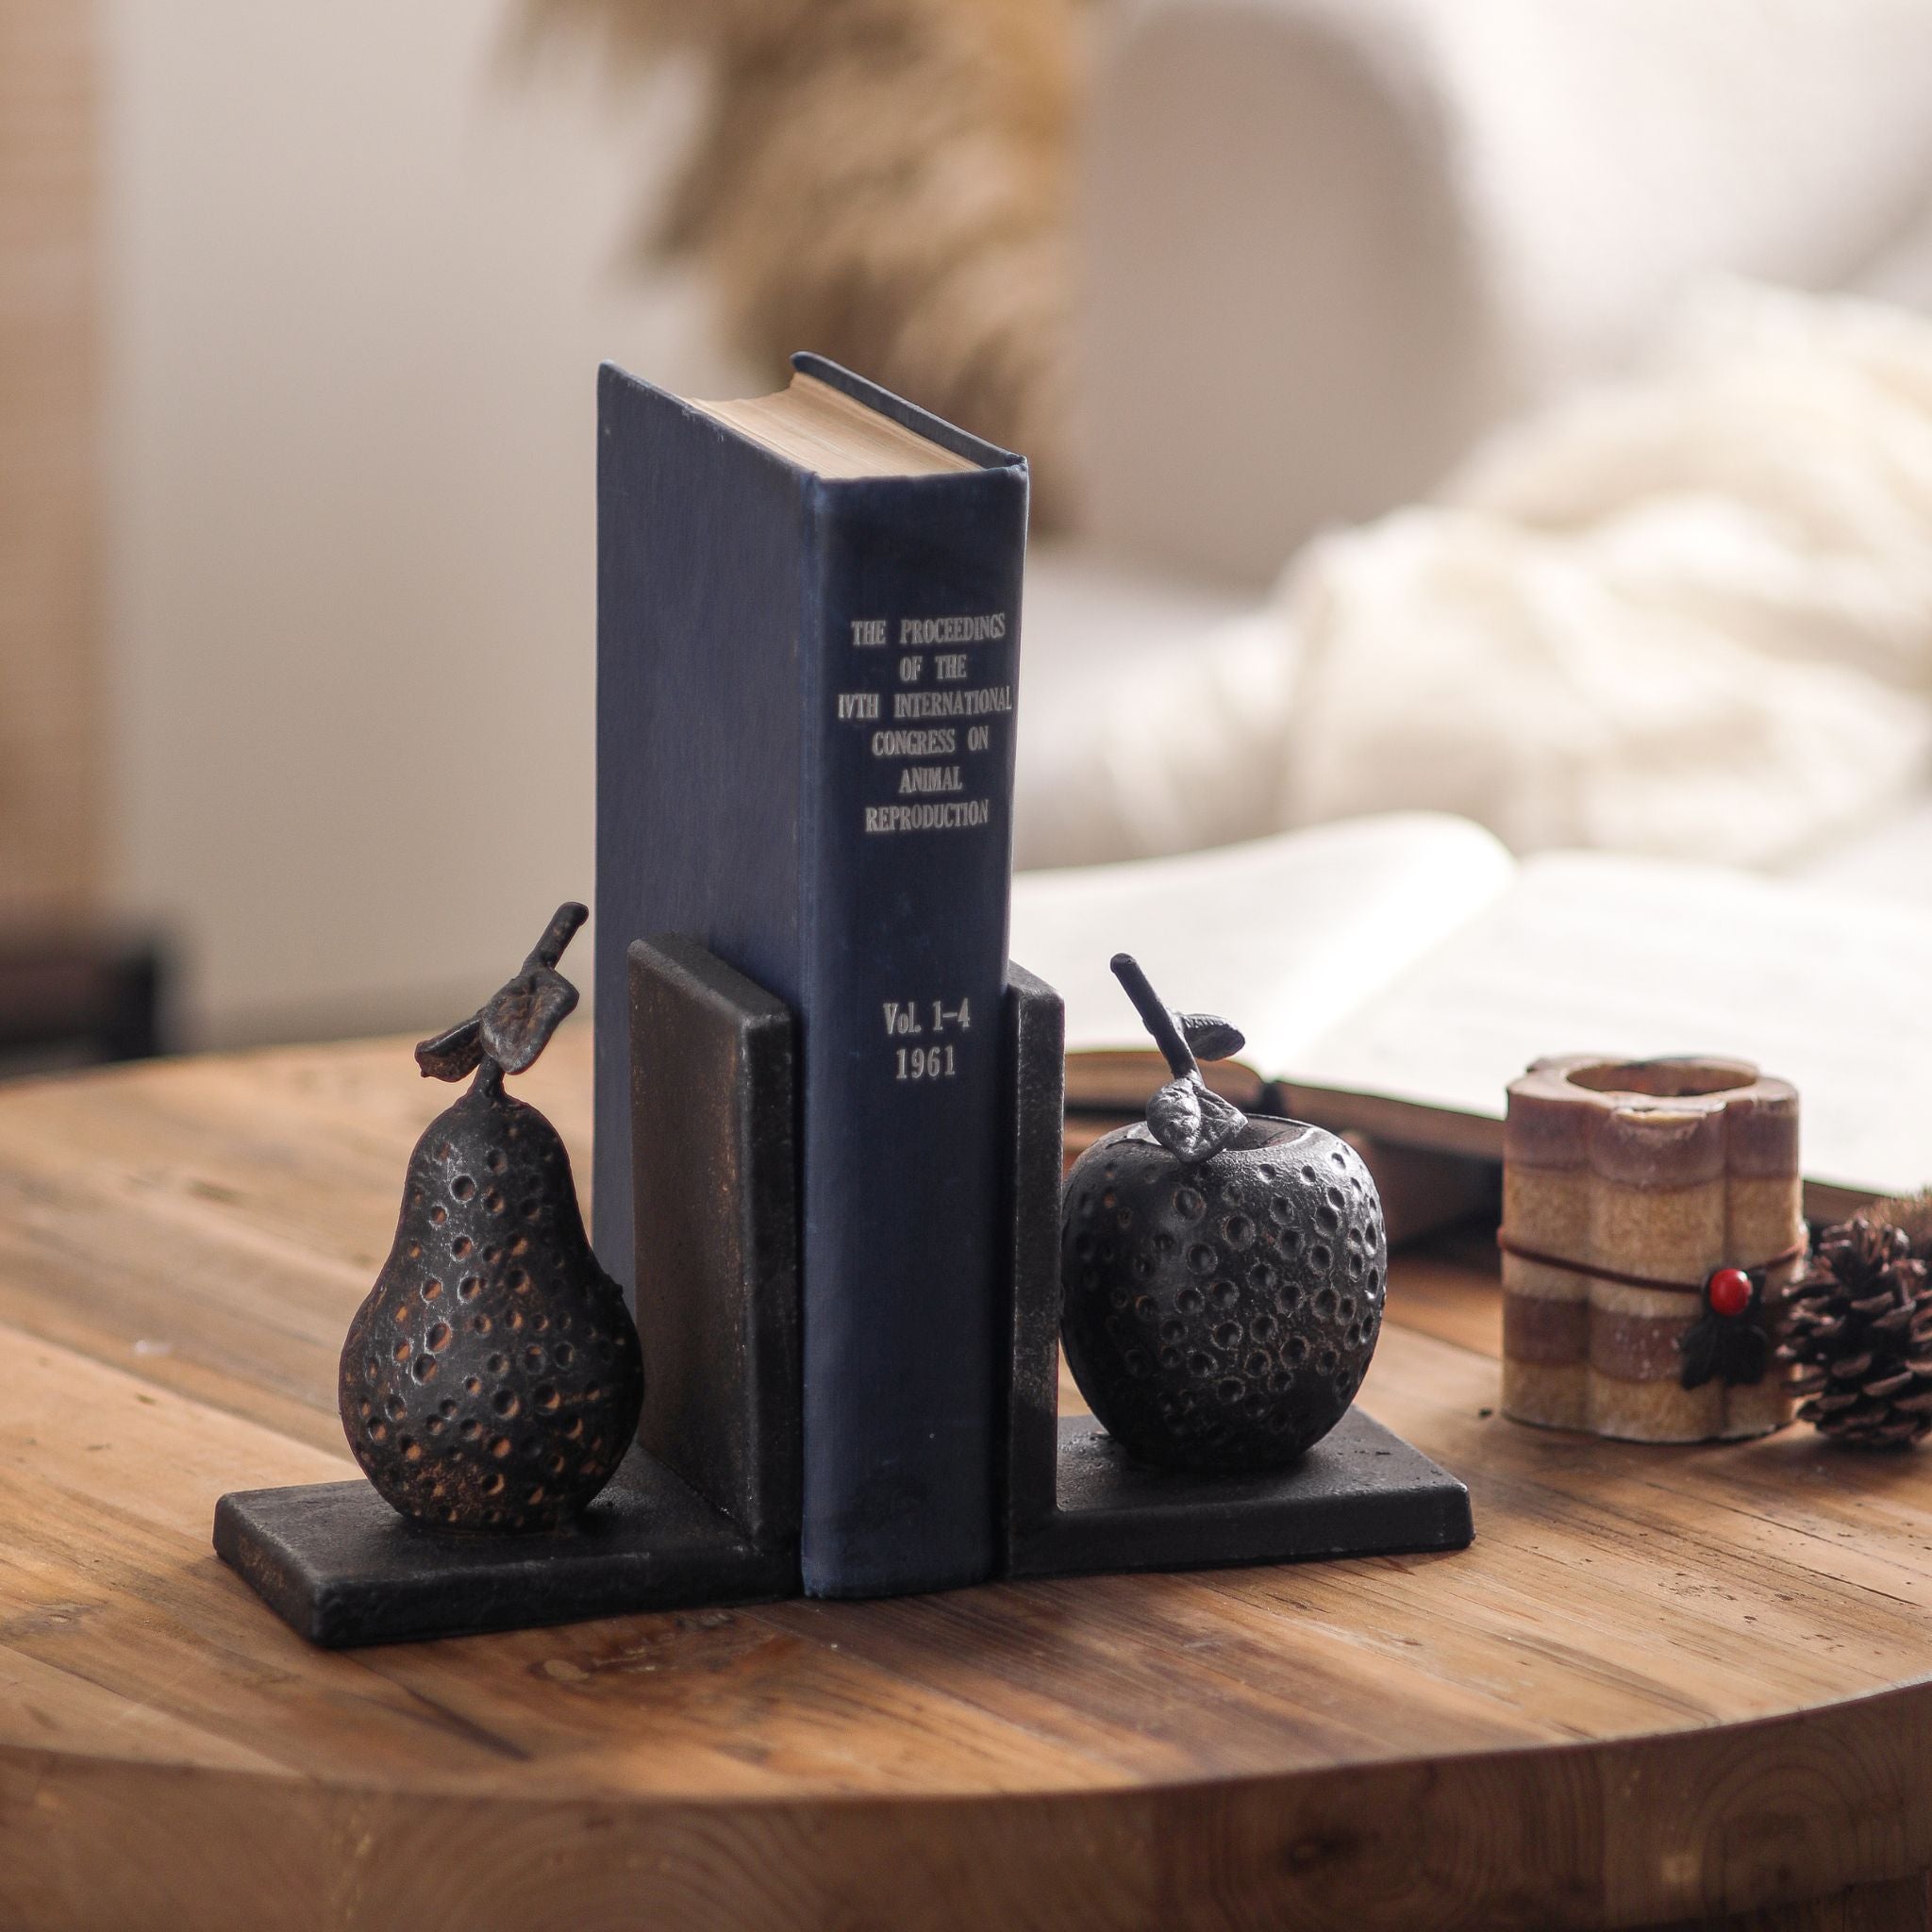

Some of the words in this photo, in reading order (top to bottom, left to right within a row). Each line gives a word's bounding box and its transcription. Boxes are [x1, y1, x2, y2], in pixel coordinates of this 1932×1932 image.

[851, 619, 887, 646] THE
[901, 613, 1005, 644] PROCEEDINGS
[899, 656, 924, 682] OF
[935, 654, 967, 680] THE
[838, 692, 880, 719] IVTH
[894, 686, 1012, 718] INTERNATIONAL
[872, 728, 956, 757] CONGRESS
[967, 725, 990, 752] ON
[899, 767, 962, 793] ANIMAL
[866, 800, 989, 831] REPRODUCTION
[883, 1001, 922, 1035] Vol.
[895, 1044, 956, 1079] 1961
